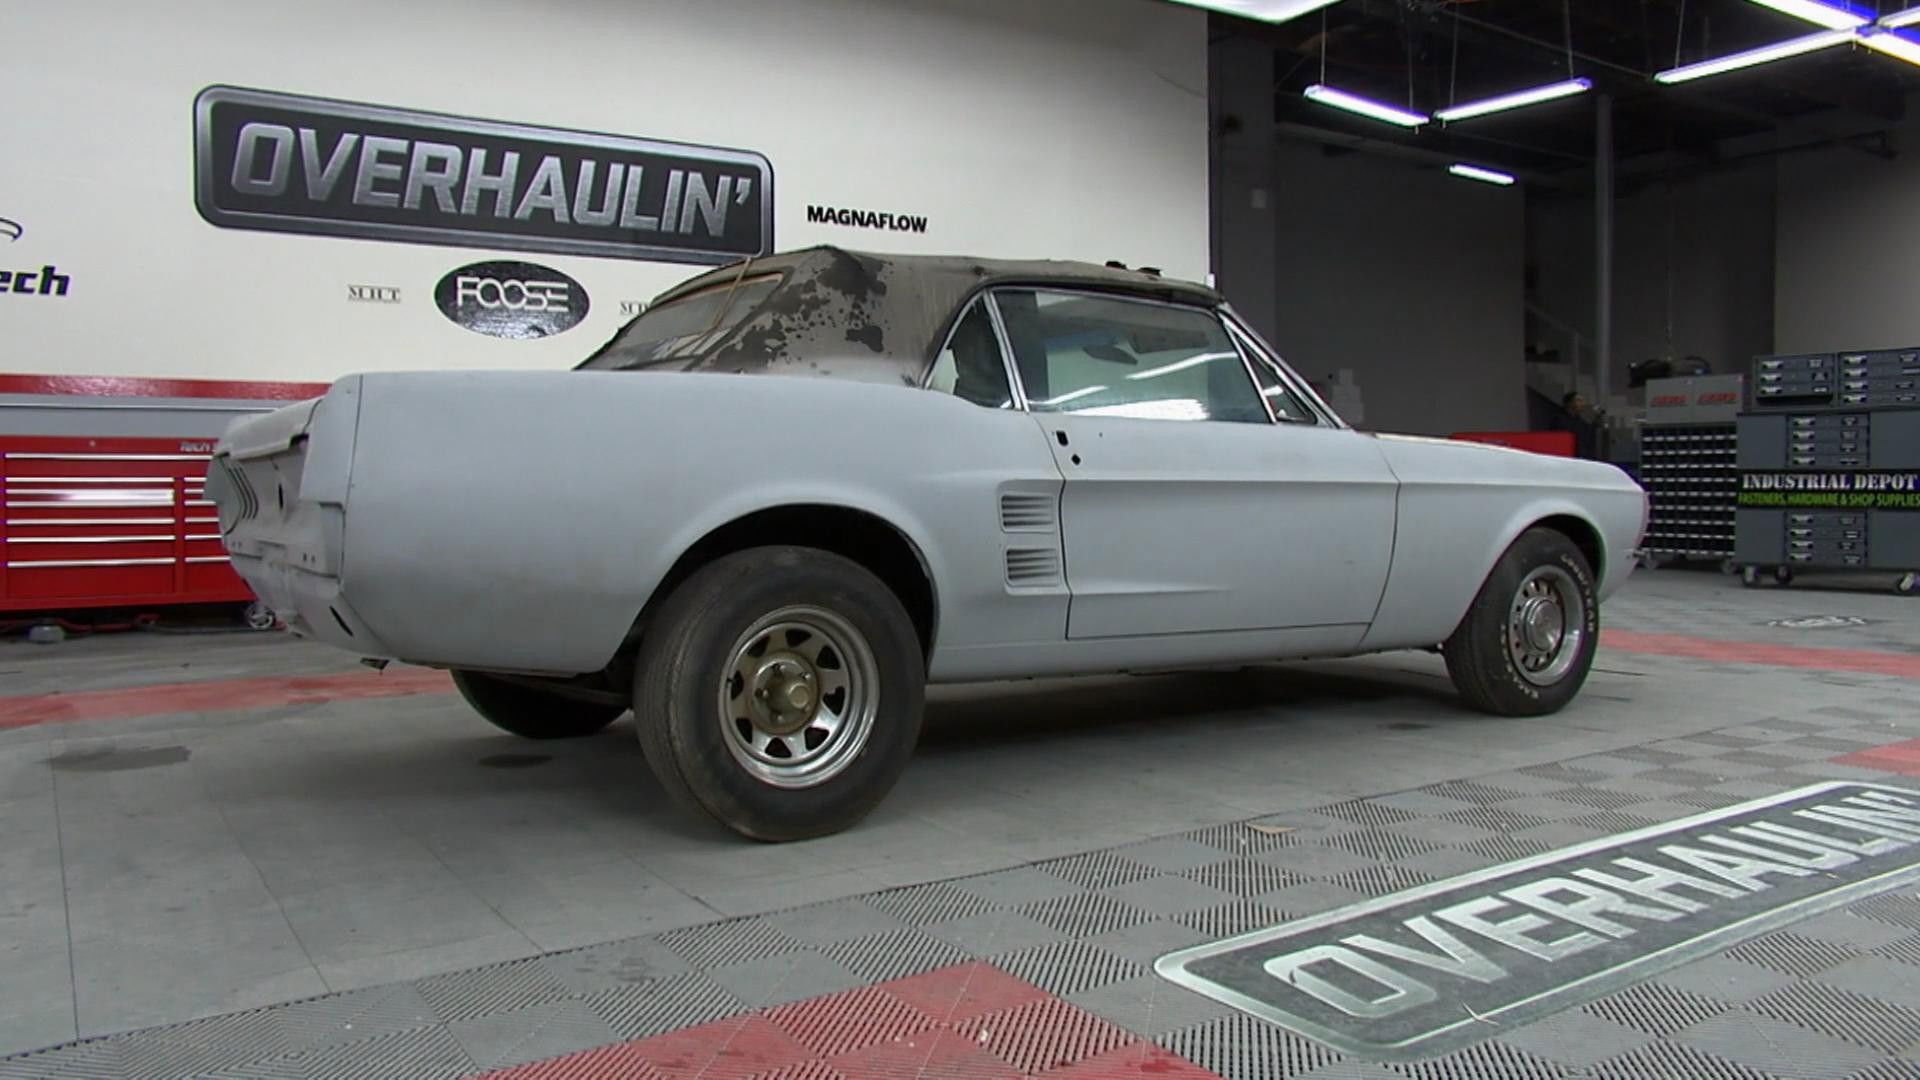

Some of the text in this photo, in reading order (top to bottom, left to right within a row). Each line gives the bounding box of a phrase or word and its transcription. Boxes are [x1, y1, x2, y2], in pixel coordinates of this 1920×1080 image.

[231, 121, 752, 237] OVERHAULIN'
[806, 203, 928, 233] MAGNAFLOW
[456, 274, 569, 313] FOOSE
[1742, 473, 1918, 490] INDUSTRIAL DEPOT
[1850, 492, 1875, 505] SHOP
